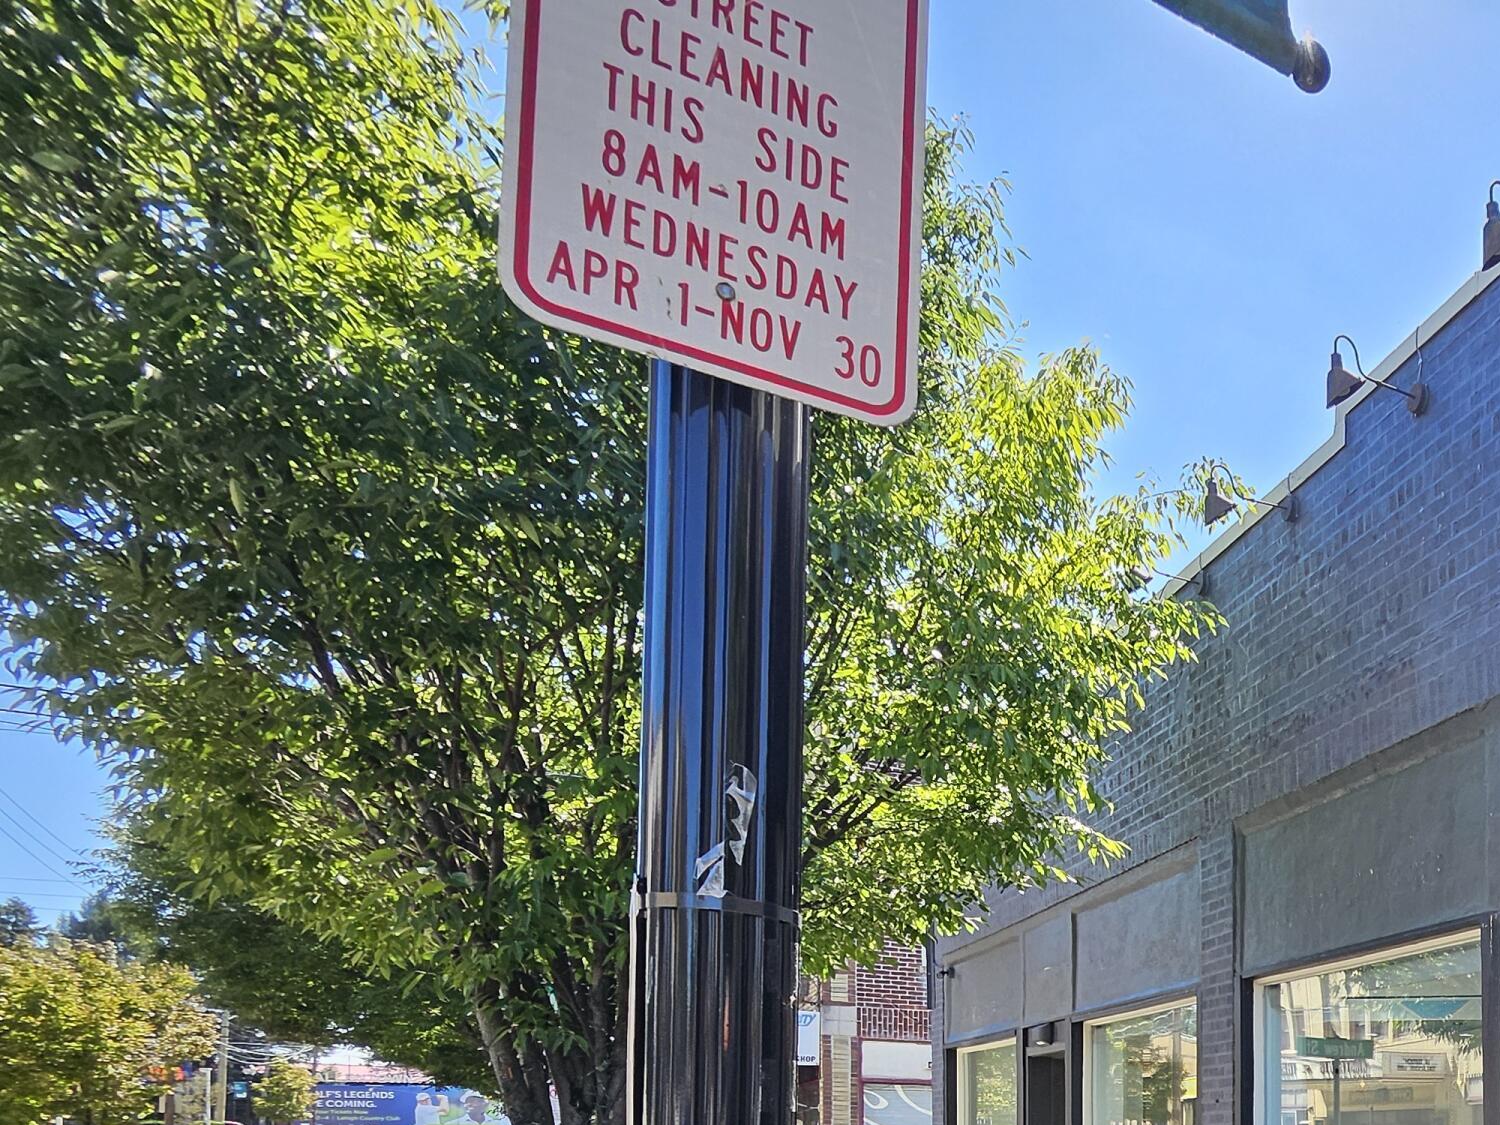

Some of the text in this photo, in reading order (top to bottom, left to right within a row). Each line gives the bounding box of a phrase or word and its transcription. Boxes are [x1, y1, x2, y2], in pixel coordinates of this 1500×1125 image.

[603, 62, 849, 203] THIS SIDE
[620, 9, 838, 138] CLEANING
[581, 183, 858, 320] WEDNESDAY
[602, 129, 845, 261] 8AM-10AM
[546, 241, 881, 387] APR 1-NOV 30
[344, 1091, 395, 1099] LEGENDS
